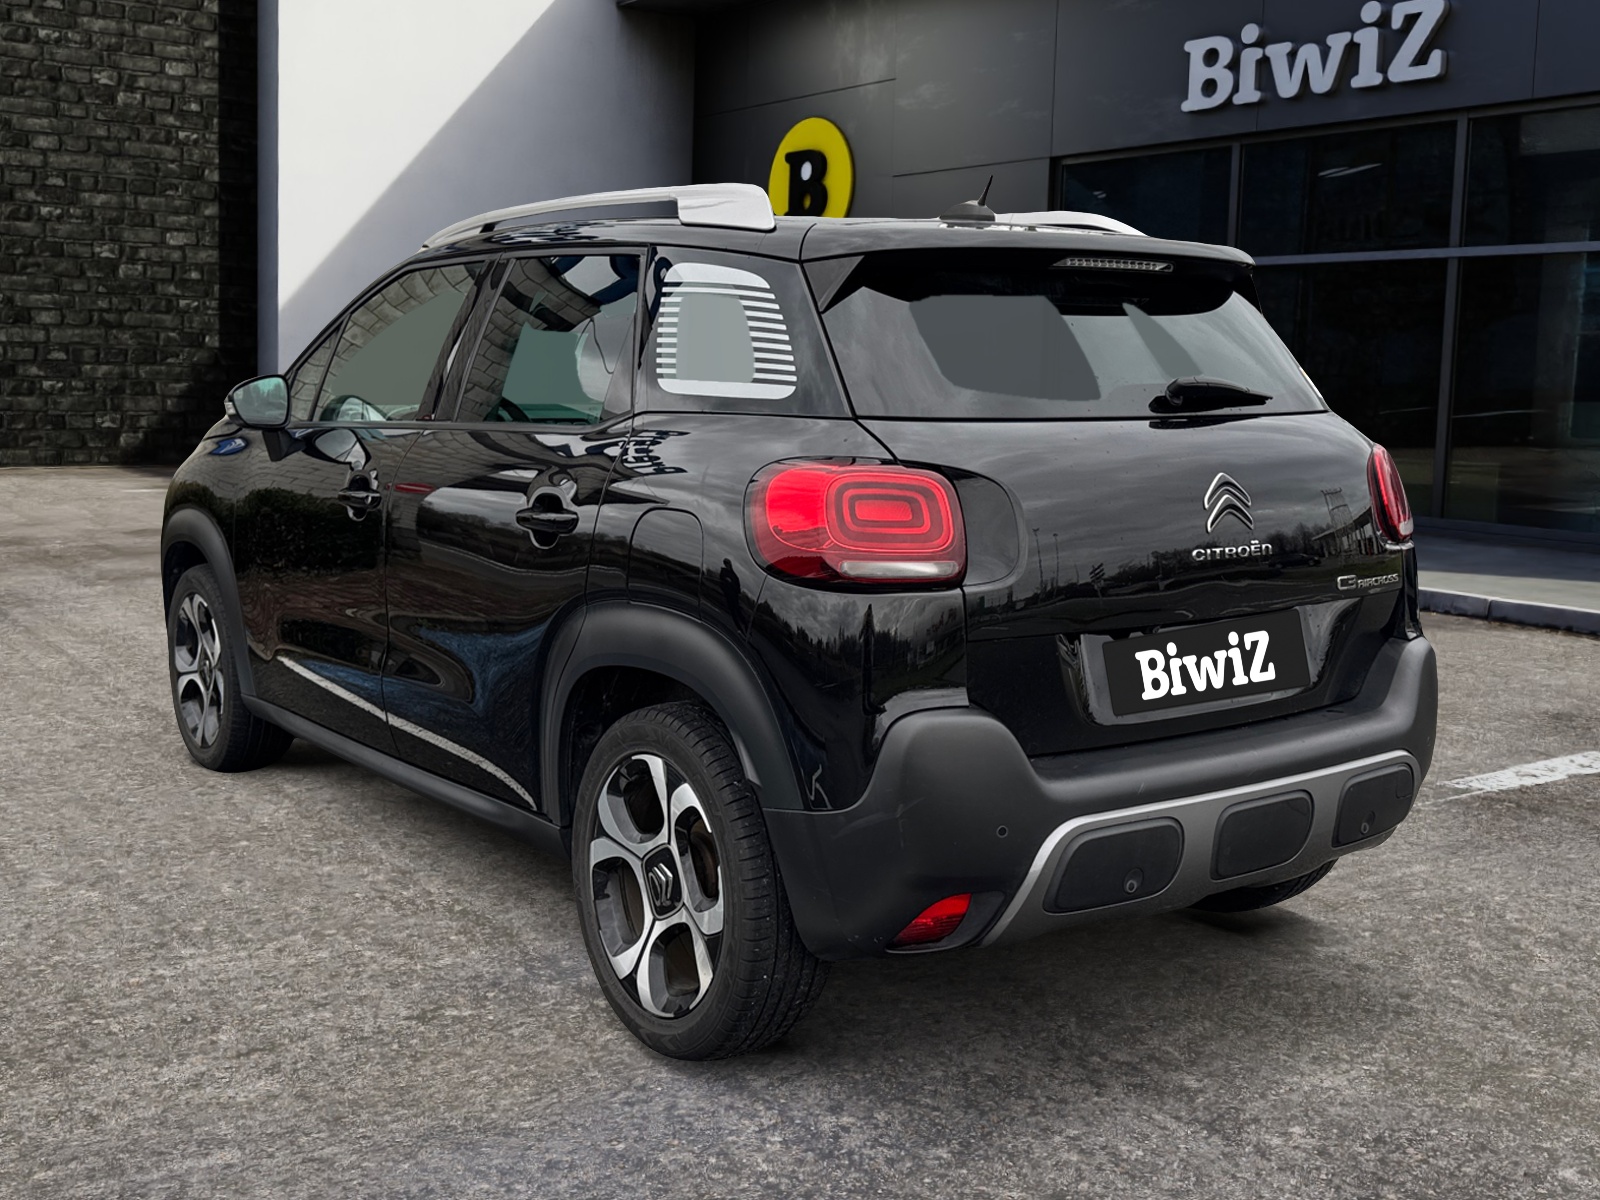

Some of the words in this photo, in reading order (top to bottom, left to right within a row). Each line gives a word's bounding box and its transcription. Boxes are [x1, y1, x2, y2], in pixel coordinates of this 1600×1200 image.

[1181, 0, 1446, 112] BiwiZ
[783, 149, 828, 216] B
[1357, 573, 1399, 589] AIRCROSS
[1134, 630, 1276, 701] BiwiZ
